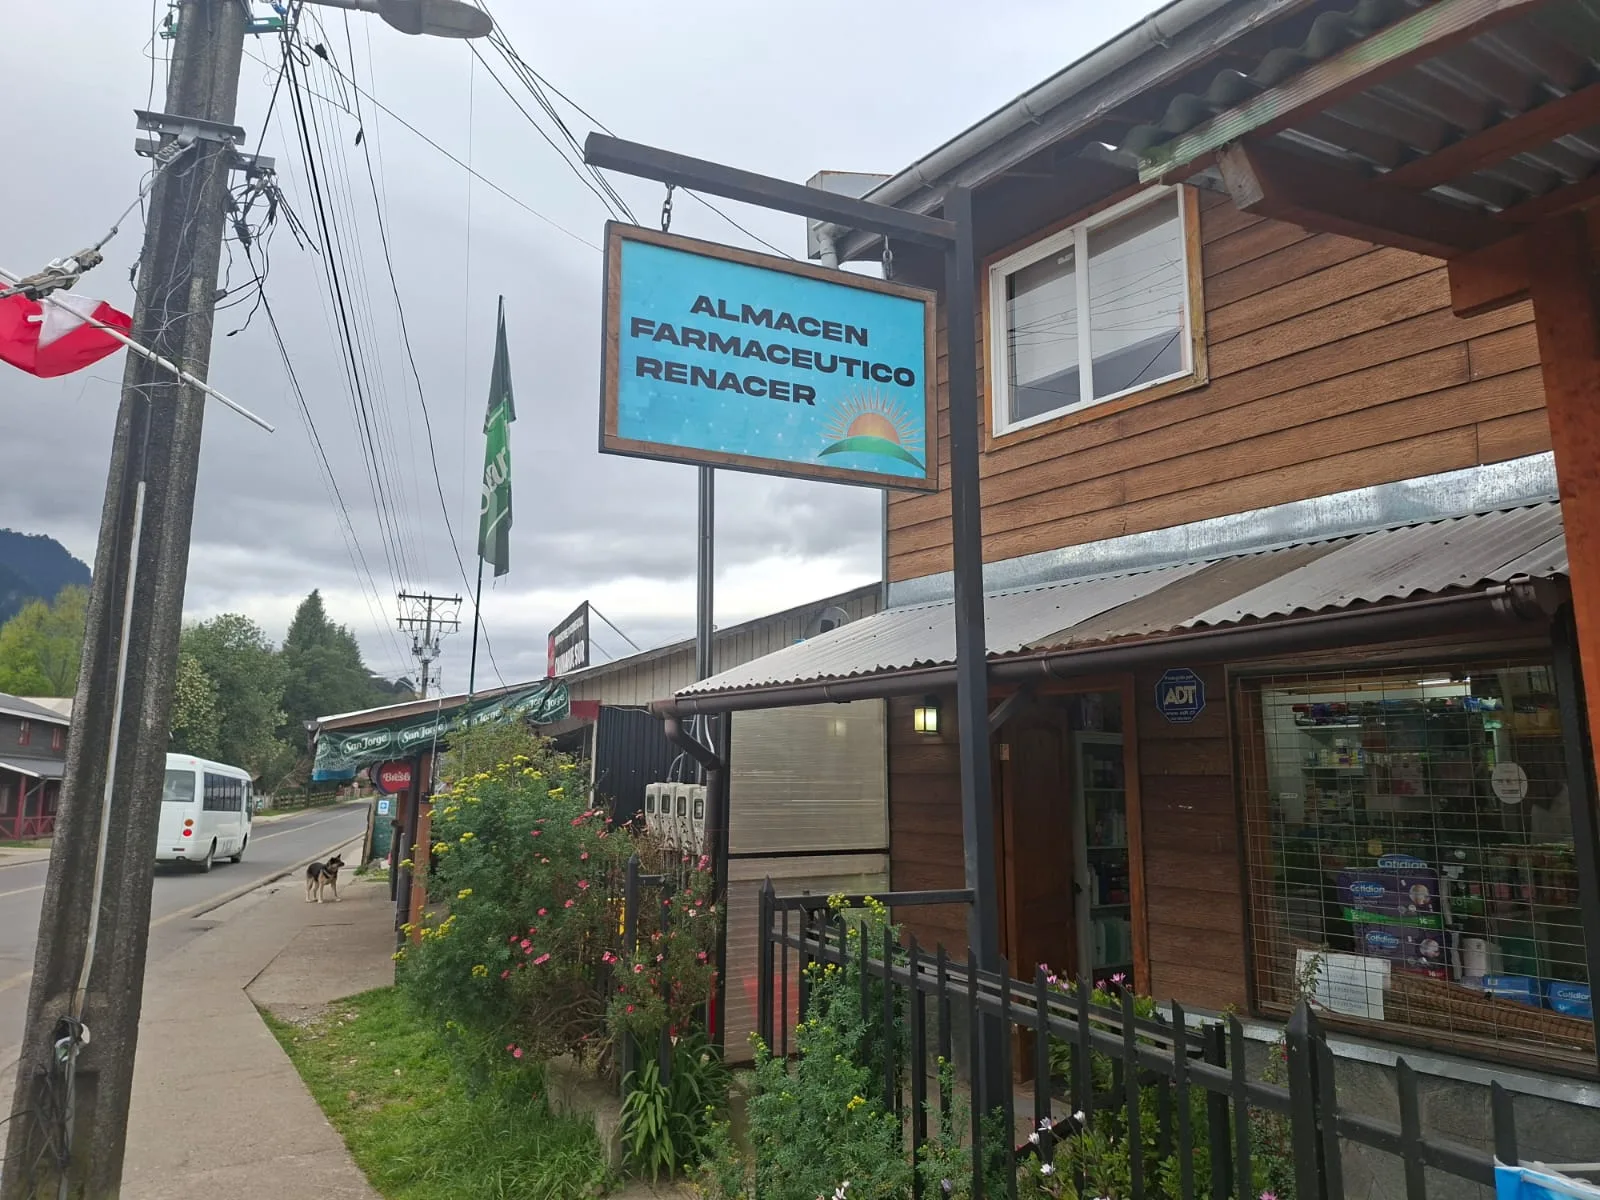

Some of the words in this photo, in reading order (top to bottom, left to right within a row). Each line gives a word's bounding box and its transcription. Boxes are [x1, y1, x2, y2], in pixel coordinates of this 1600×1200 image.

[690, 295, 868, 346] ALMACEN
[630, 316, 916, 387] FARMACEUTICO
[635, 355, 816, 406] RENACER
[1164, 685, 1197, 705] ADT
[402, 730, 420, 743] San
[420, 722, 445, 738] Jorge
[344, 741, 362, 753] San
[362, 734, 388, 749] Jorge
[1350, 884, 1385, 893] Cotidian
[1366, 933, 1400, 945] Cotidian
